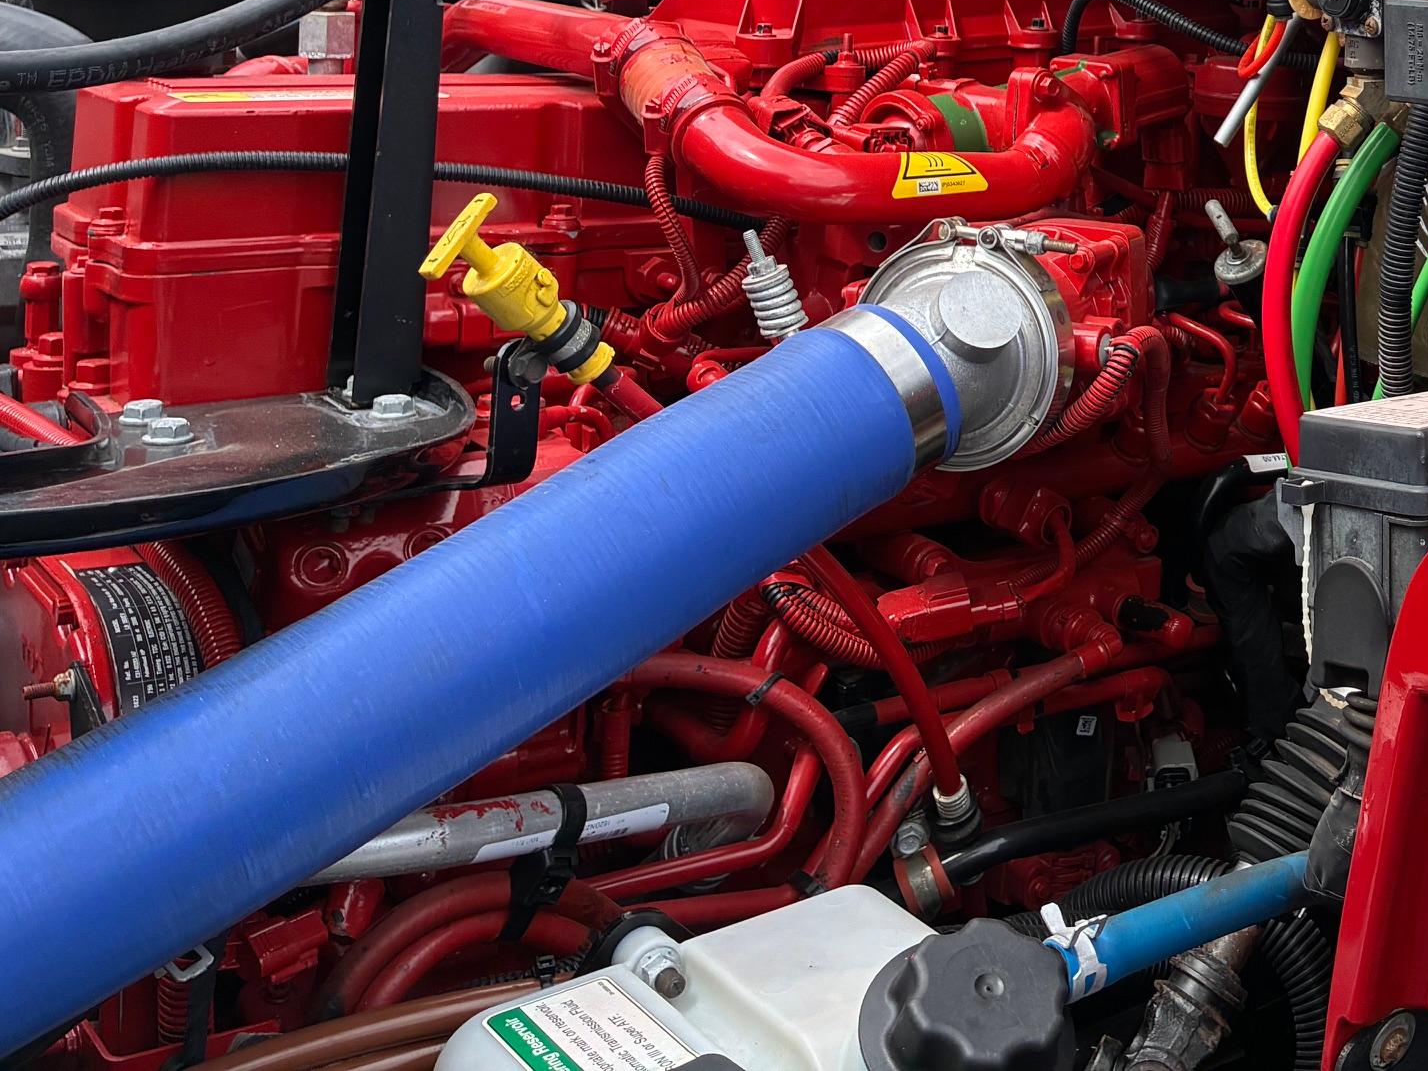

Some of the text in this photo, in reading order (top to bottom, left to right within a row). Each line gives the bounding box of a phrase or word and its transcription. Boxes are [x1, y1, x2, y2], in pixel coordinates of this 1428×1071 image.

[535, 1001, 566, 1028] reservoir.
[560, 998, 583, 1016] Fluid
[607, 1012, 629, 1029] ATF.
[505, 1015, 549, 1054] Reservoir
[562, 1026, 574, 1037] on
[578, 1013, 621, 1052] Transmission
[622, 1024, 644, 1044] Super
[569, 1035, 591, 1052] mark
[641, 1041, 653, 1050] or
